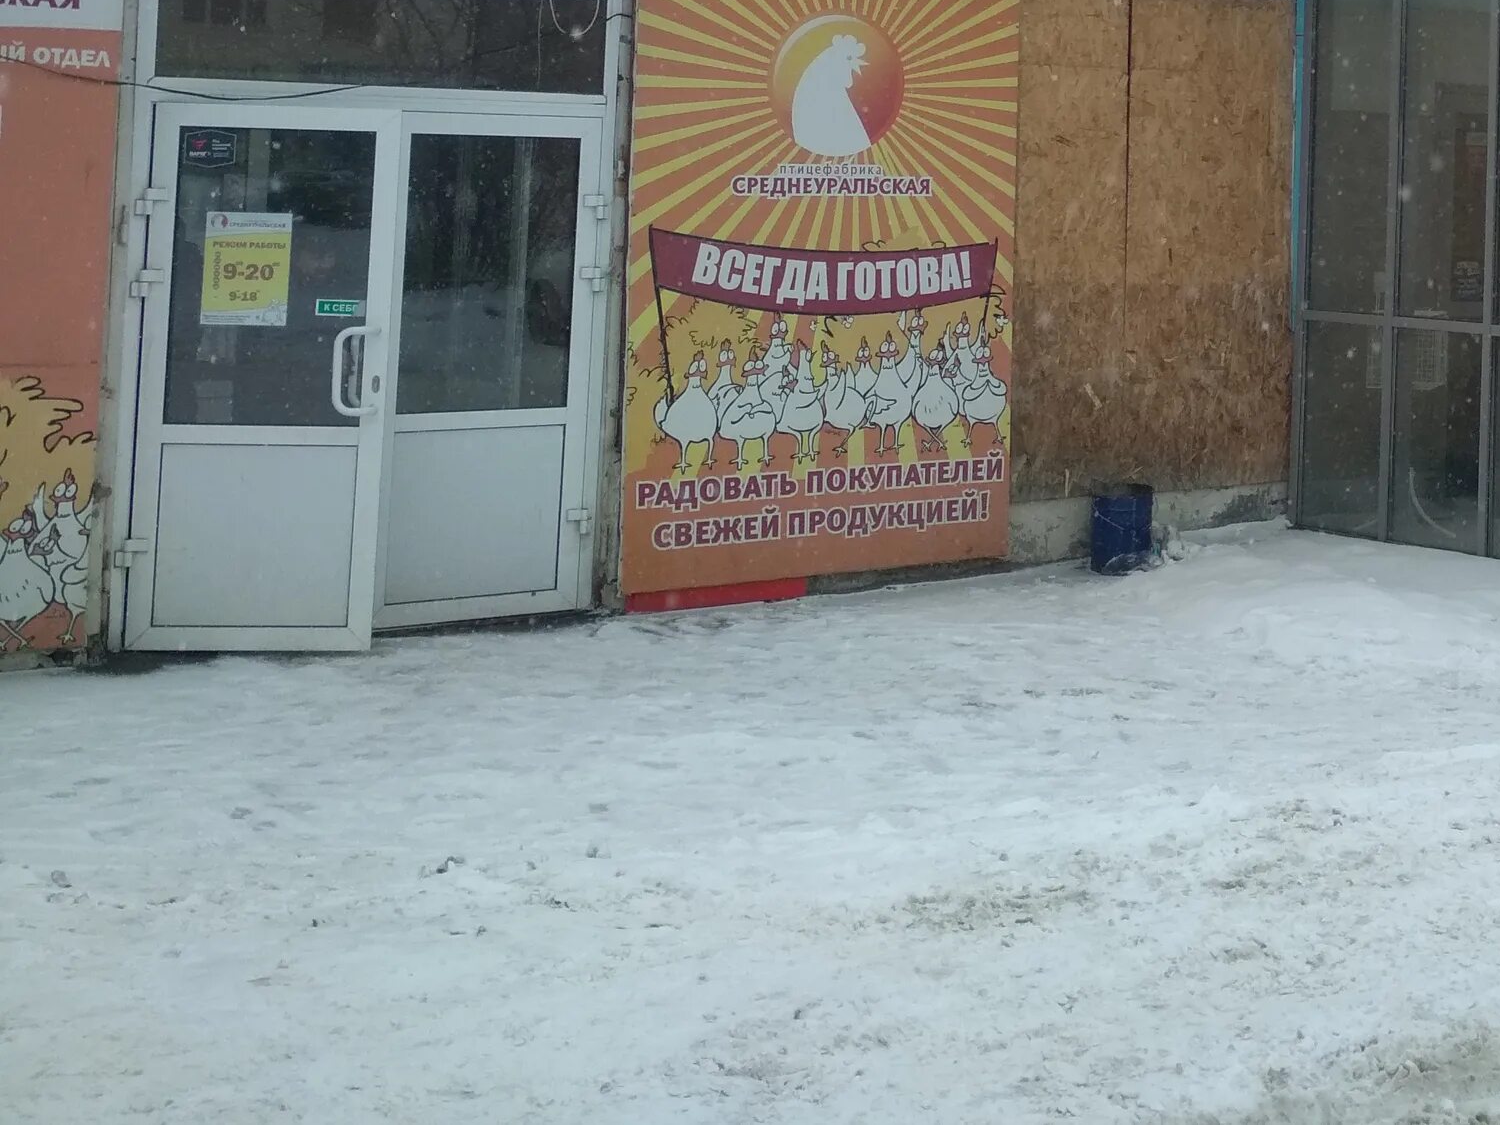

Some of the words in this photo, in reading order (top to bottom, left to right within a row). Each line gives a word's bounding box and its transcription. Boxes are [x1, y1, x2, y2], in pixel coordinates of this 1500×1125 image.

[33, 46, 110, 69] ОТДЕЛ
[779, 164, 881, 176] птицефабрика
[732, 177, 931, 197] СРЕДНЕУРАЛЬСКАЯ
[213, 241, 247, 249] РЕЖИМ
[249, 241, 287, 249] РАБОТЫ
[691, 243, 829, 306] ВСЕГДА
[837, 250, 973, 301] ГОТОВА!
[323, 303, 331, 312] К
[636, 476, 798, 511] РАДОВАТЬ
[806, 450, 1005, 494] ПОКУПАТЕЛЕЙ
[653, 506, 780, 550] СВЕЖЕЙ
[787, 491, 990, 538] ПРОДУКЦИЕЙ!
